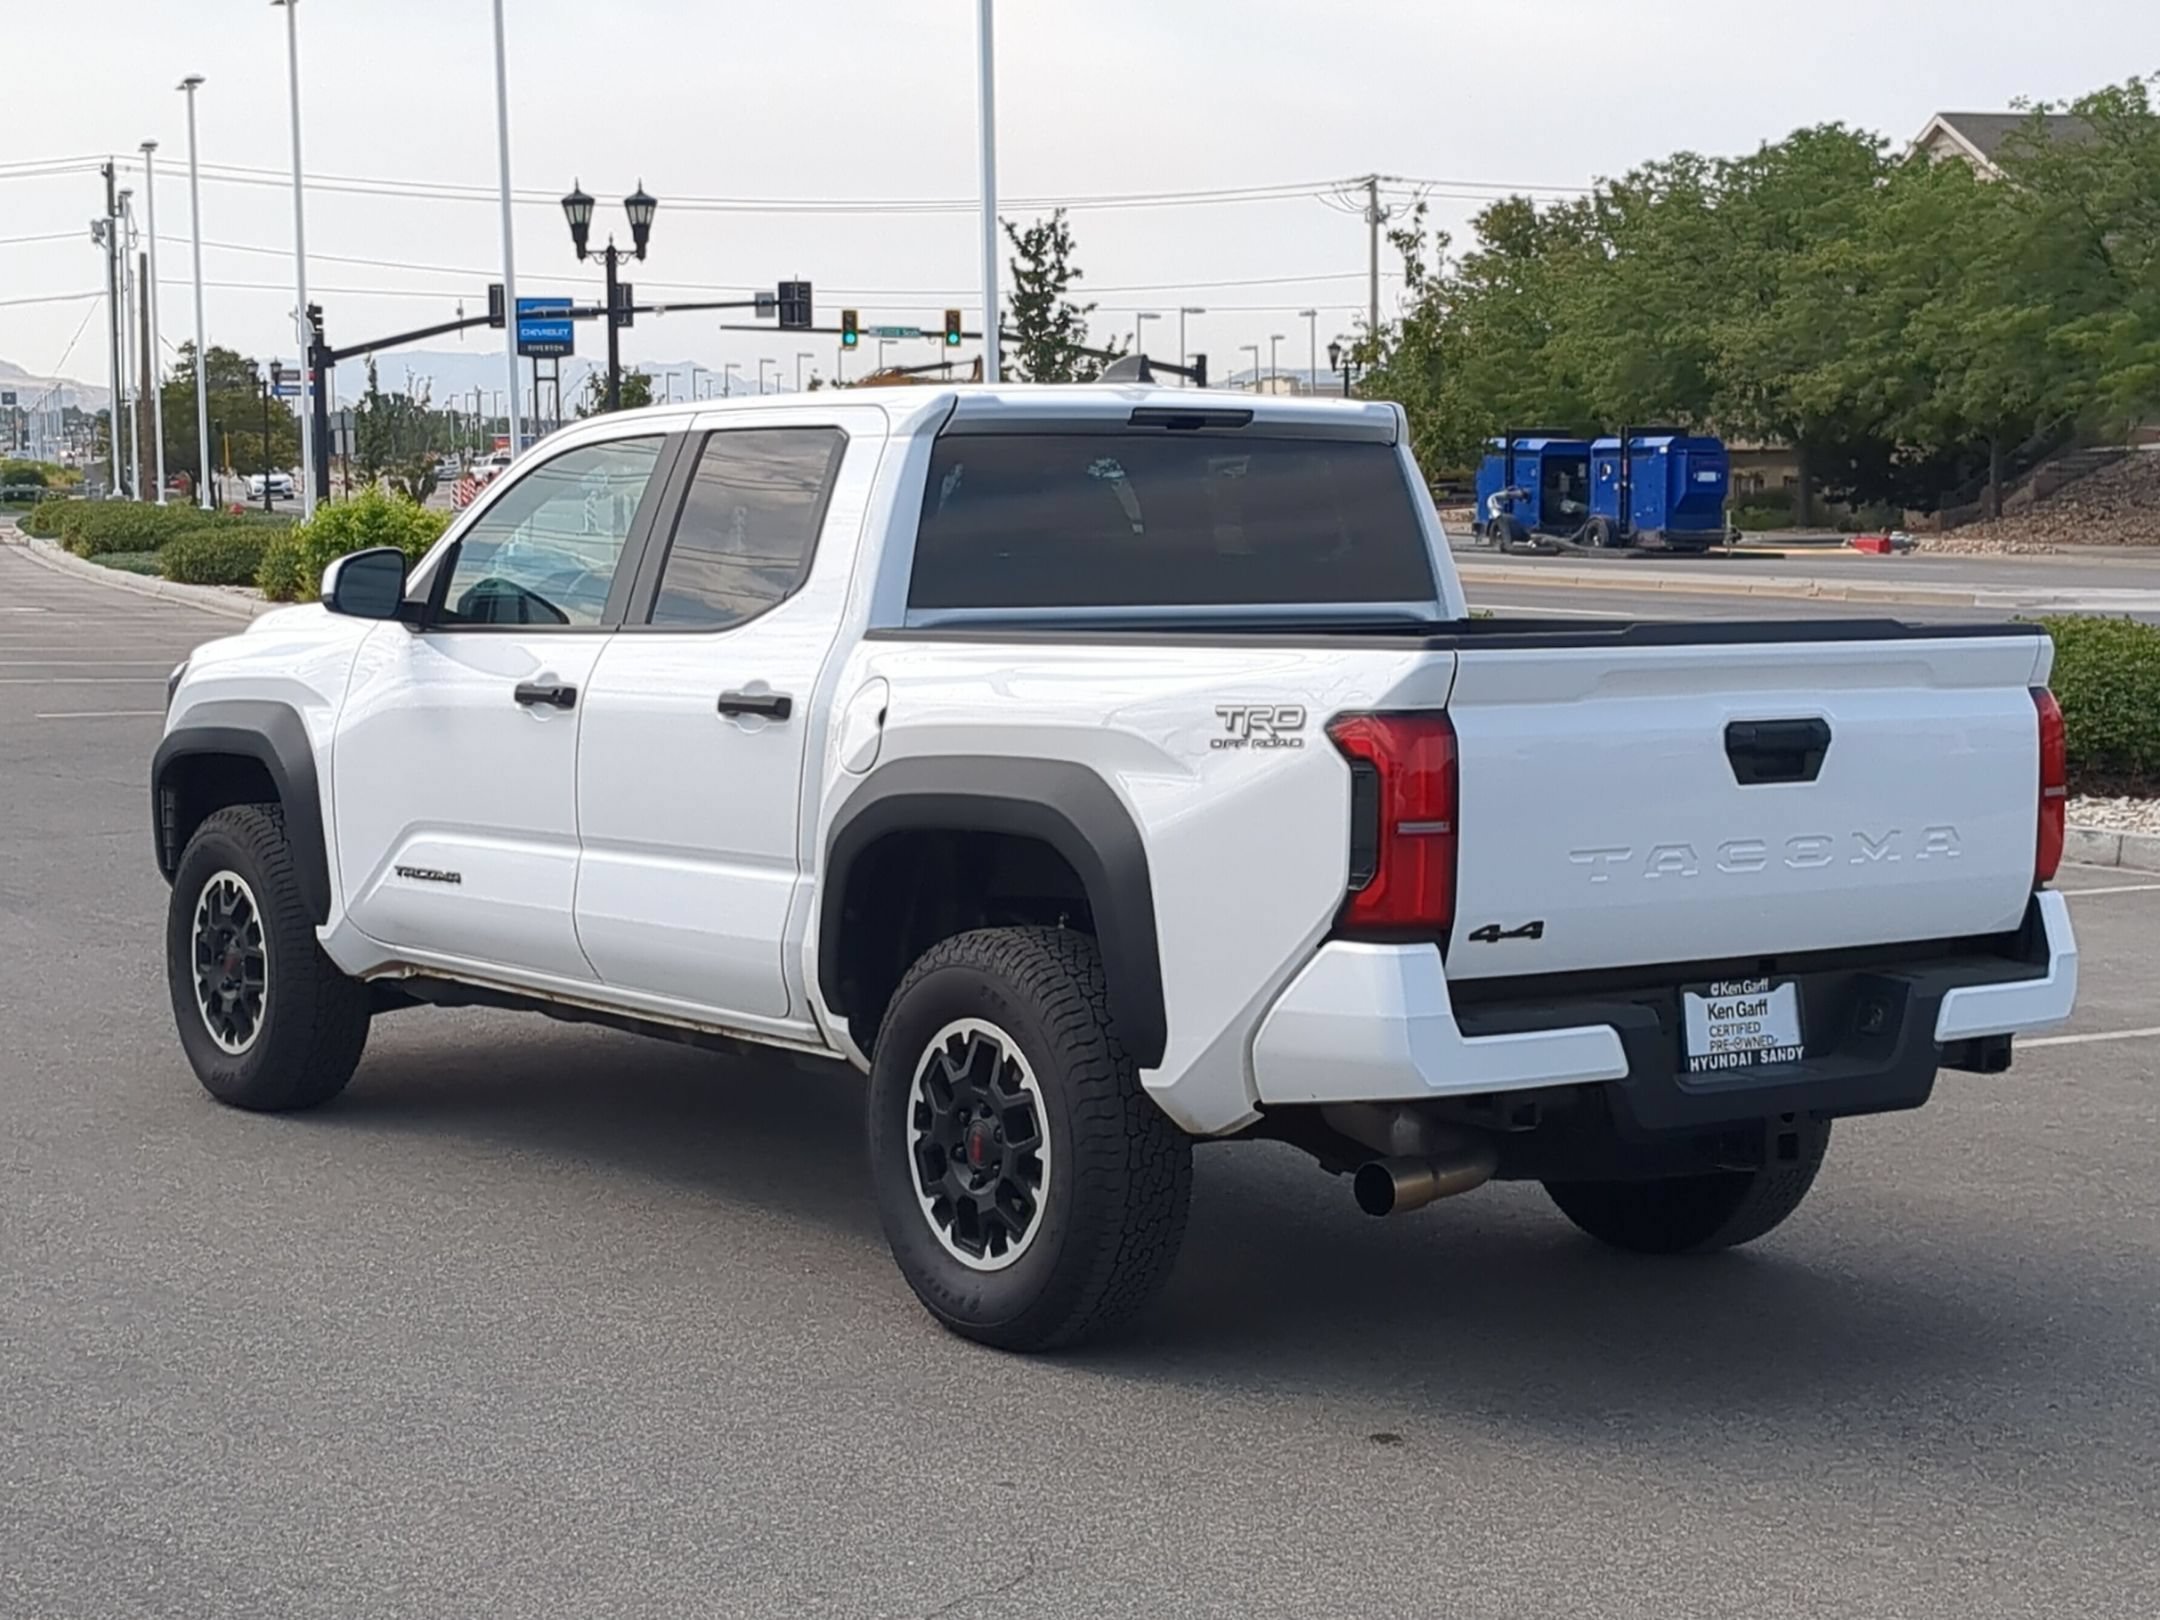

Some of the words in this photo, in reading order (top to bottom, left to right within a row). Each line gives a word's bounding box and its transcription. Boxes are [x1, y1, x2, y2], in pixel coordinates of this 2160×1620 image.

[521, 328, 569, 337] CHEVROLET
[1215, 704, 1307, 739] TRD
[1210, 738, 1249, 750] OFF
[1251, 738, 1304, 750] ROAD
[1568, 825, 1961, 882] TACOMA
[394, 865, 462, 885] TACOMA
[1720, 981, 1742, 995] Ken
[1743, 978, 1769, 994] Garff
[1707, 1002, 1735, 1021] Ken
[1736, 998, 1769, 1018] Garff
[1709, 1021, 1762, 1038] CERTIFIED
[1690, 1051, 1752, 1072] HYUNDAI
[1760, 1045, 1805, 1064] SANDY
